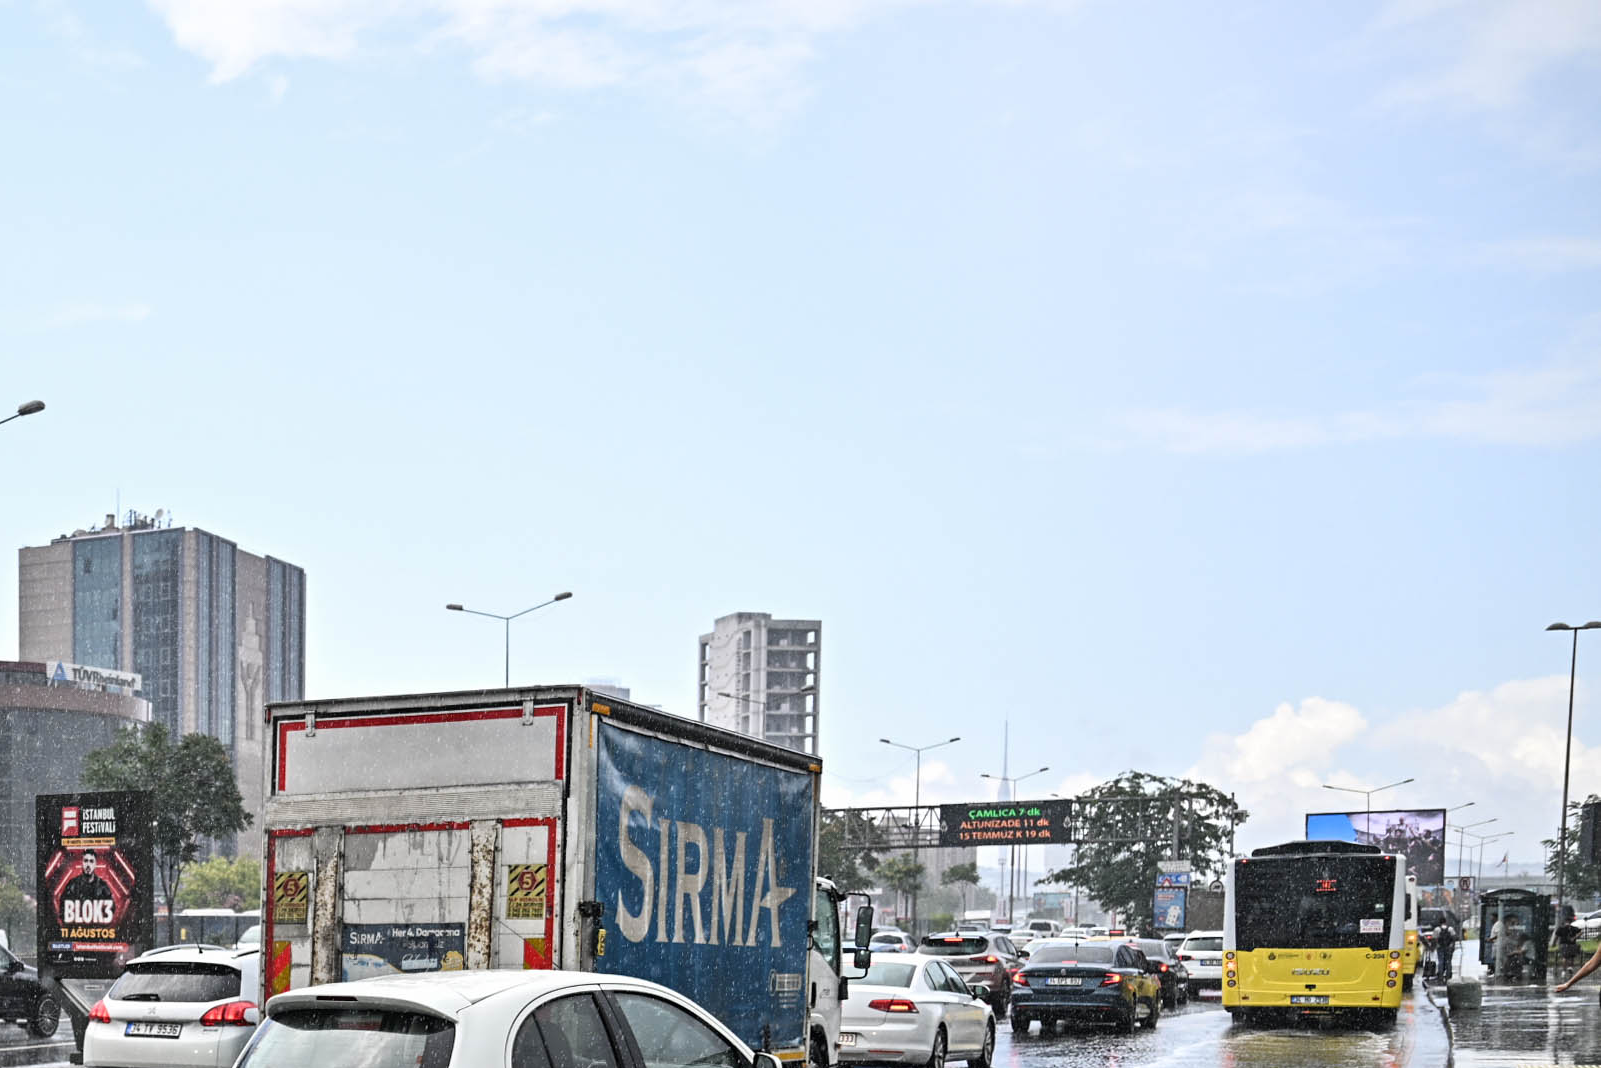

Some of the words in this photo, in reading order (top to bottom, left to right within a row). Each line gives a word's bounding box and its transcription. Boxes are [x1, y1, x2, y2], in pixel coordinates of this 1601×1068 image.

[1018, 808, 1025, 816] 7
[1027, 807, 1041, 816] dk
[1024, 819, 1034, 827] 11
[1037, 818, 1050, 826] dk
[959, 832, 970, 840] 15
[973, 831, 1013, 839] TEMMUZ
[1025, 830, 1036, 838] 19
[1038, 829, 1051, 838] dk
[615, 784, 797, 948] SIRMA
[523, 873, 532, 888] 5
[287, 881, 294, 894] 5
[64, 900, 113, 923] BLOK3
[70, 926, 116, 938] AĞUSTOS
[392, 928, 406, 937] Her
